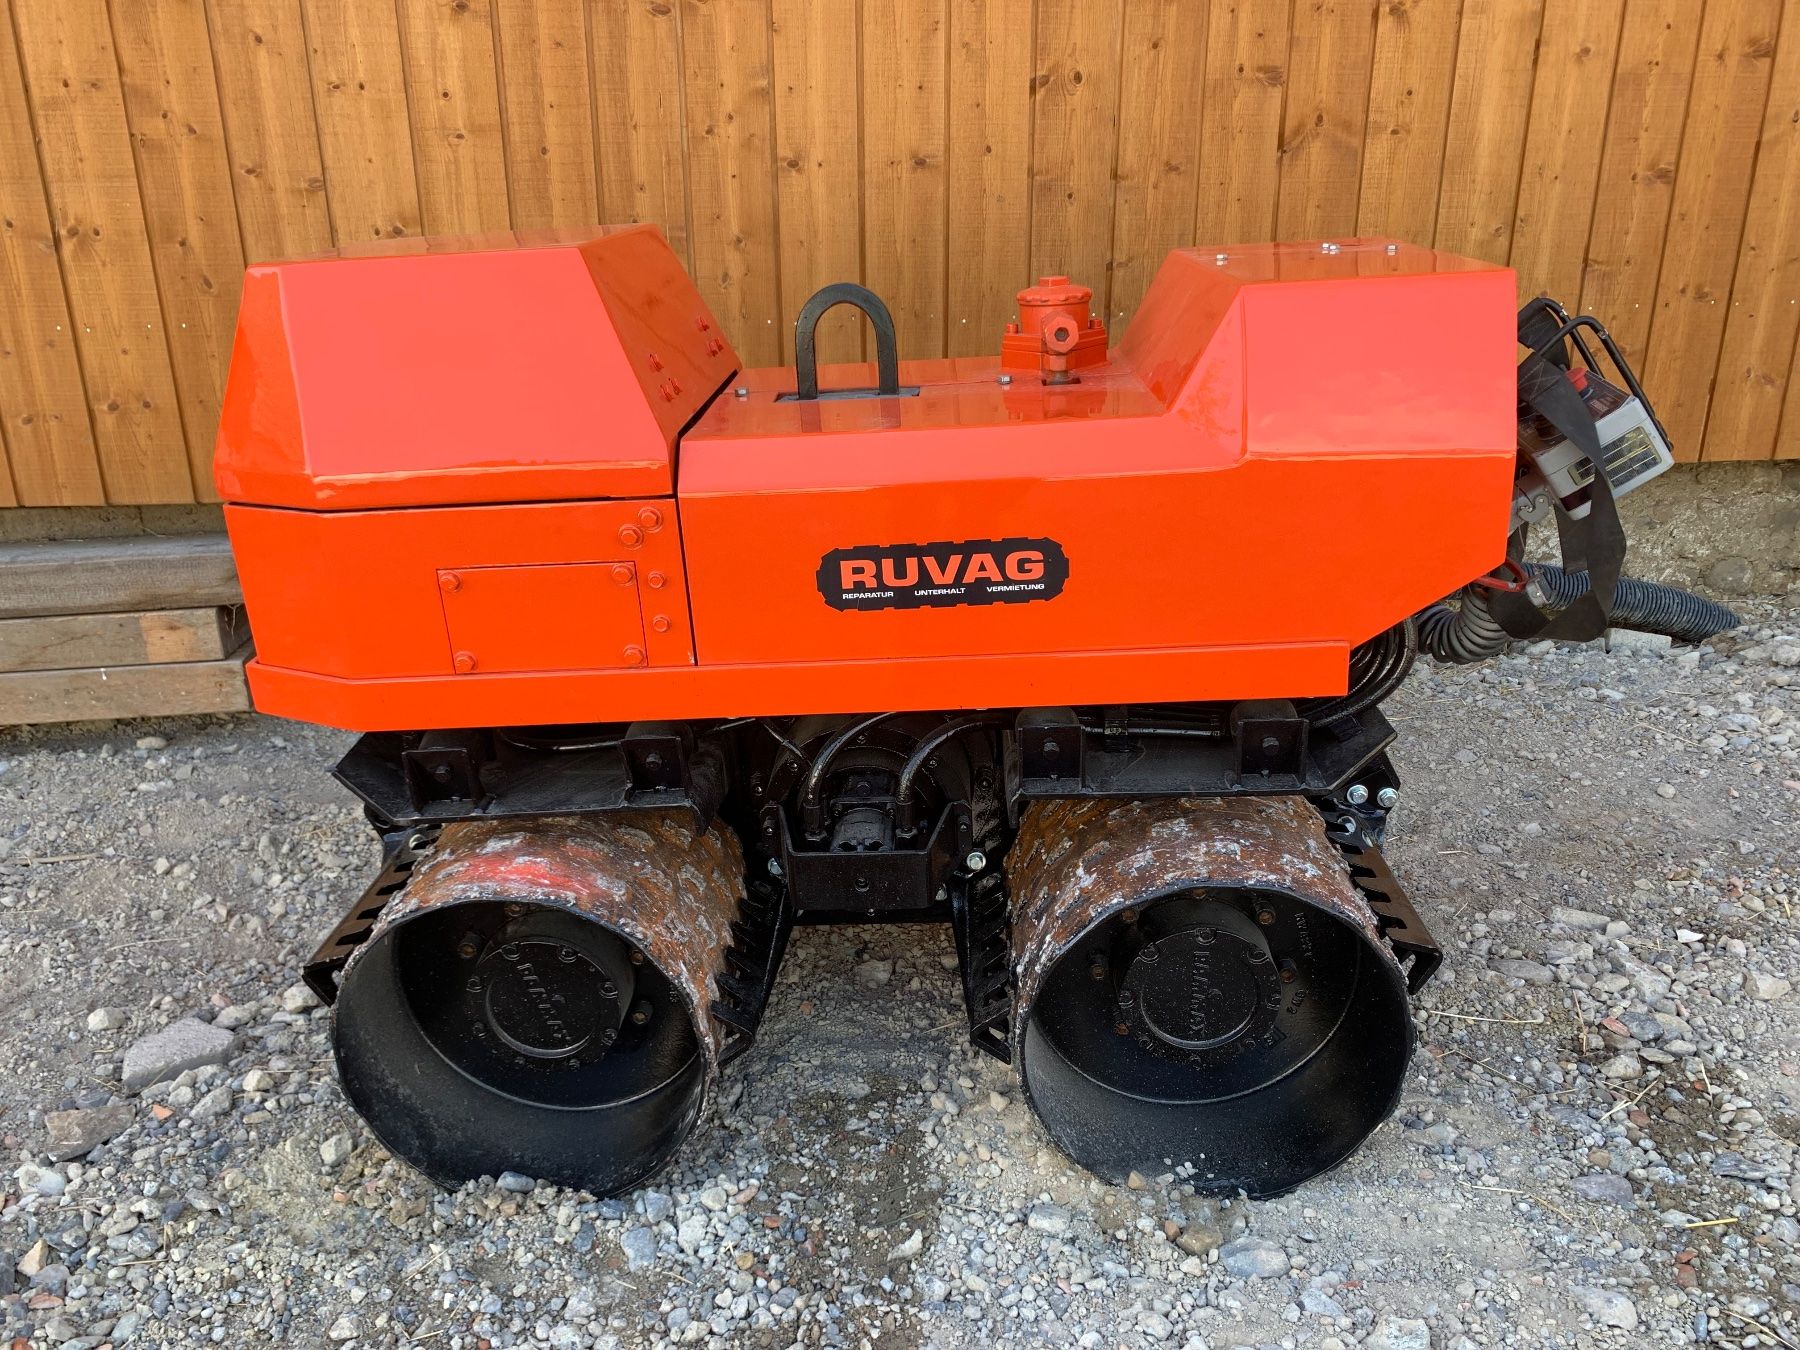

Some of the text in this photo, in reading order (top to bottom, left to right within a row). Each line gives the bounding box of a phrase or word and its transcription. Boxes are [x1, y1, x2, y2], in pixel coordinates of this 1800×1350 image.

[839, 550, 1045, 590] RUVAG
[842, 584, 1045, 600] REPARATUR UNTERHALT VERMIETUNG
